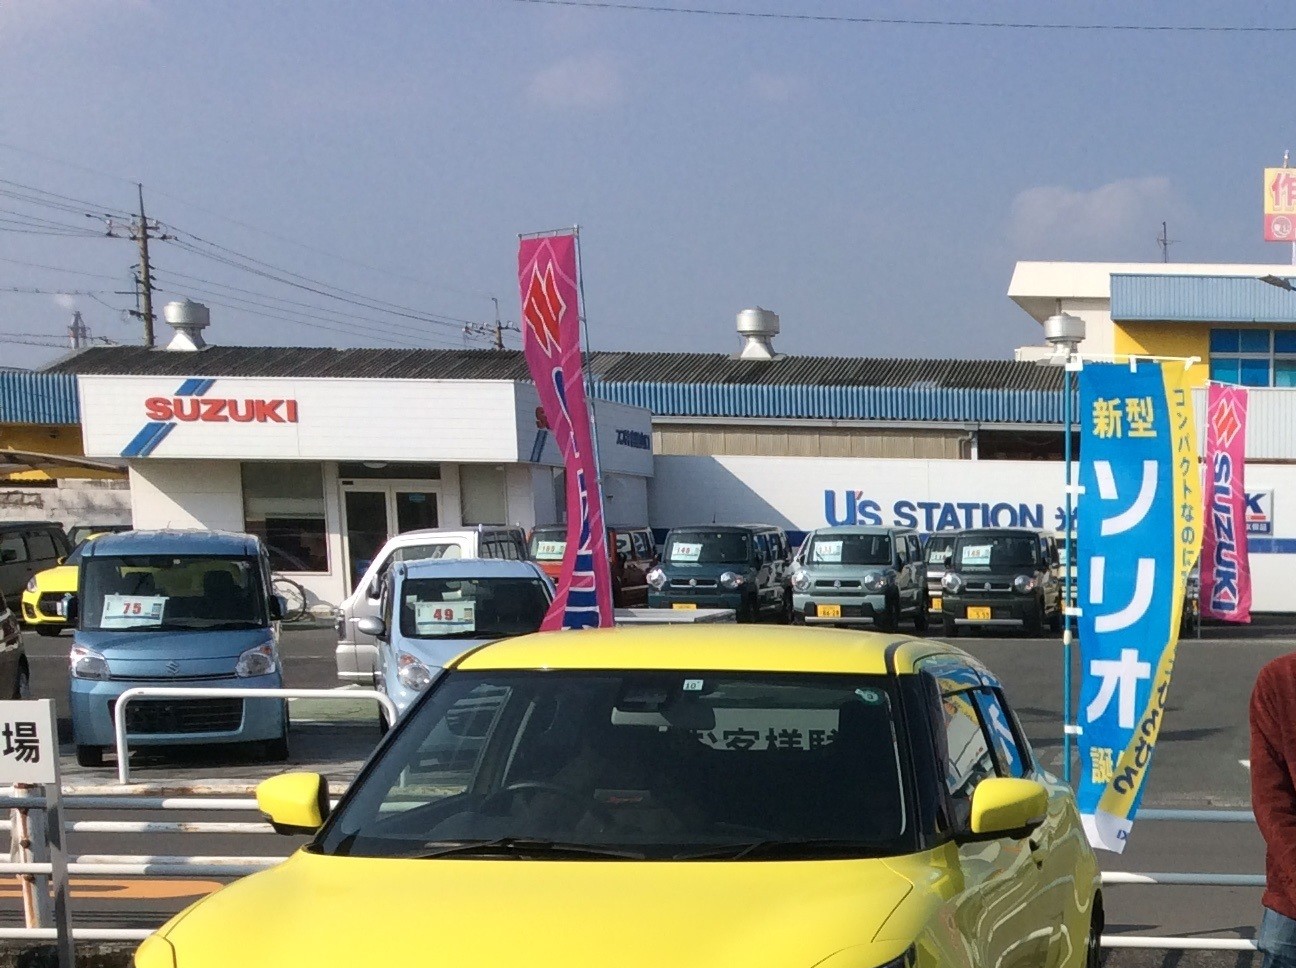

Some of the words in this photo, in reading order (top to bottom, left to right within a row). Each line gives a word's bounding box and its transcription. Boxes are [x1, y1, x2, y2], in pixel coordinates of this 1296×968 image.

[145, 397, 299, 423] SUZUKI
[1093, 397, 1157, 439] 新型
[893, 500, 1044, 532] STATION
[1210, 450, 1238, 613] SUZUKI
[123, 602, 142, 614] 75
[1086, 459, 1159, 730] ソリオ
[434, 608, 454, 621] 49
[1, 721, 40, 763] 場
